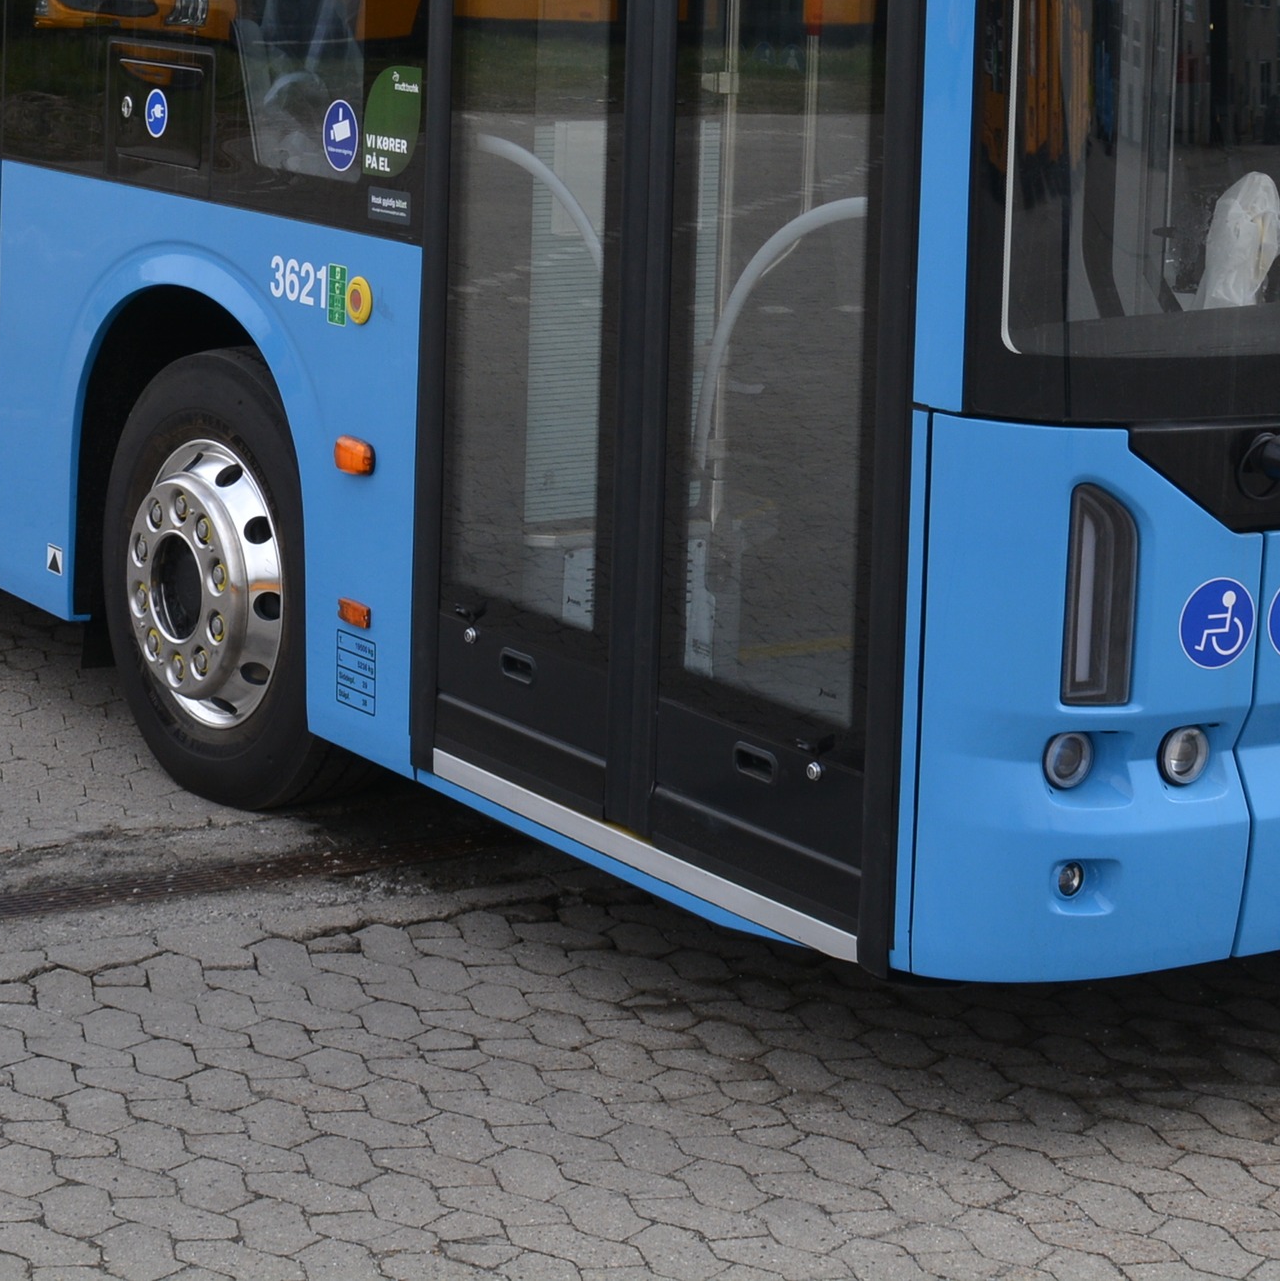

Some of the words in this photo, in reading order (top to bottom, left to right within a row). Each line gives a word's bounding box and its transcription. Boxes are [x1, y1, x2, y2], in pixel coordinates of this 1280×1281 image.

[366, 134, 375, 149] VI
[376, 135, 408, 154] KØRER
[365, 152, 378, 169] PÅ
[378, 157, 391, 172] EL
[270, 255, 327, 309] 3621
